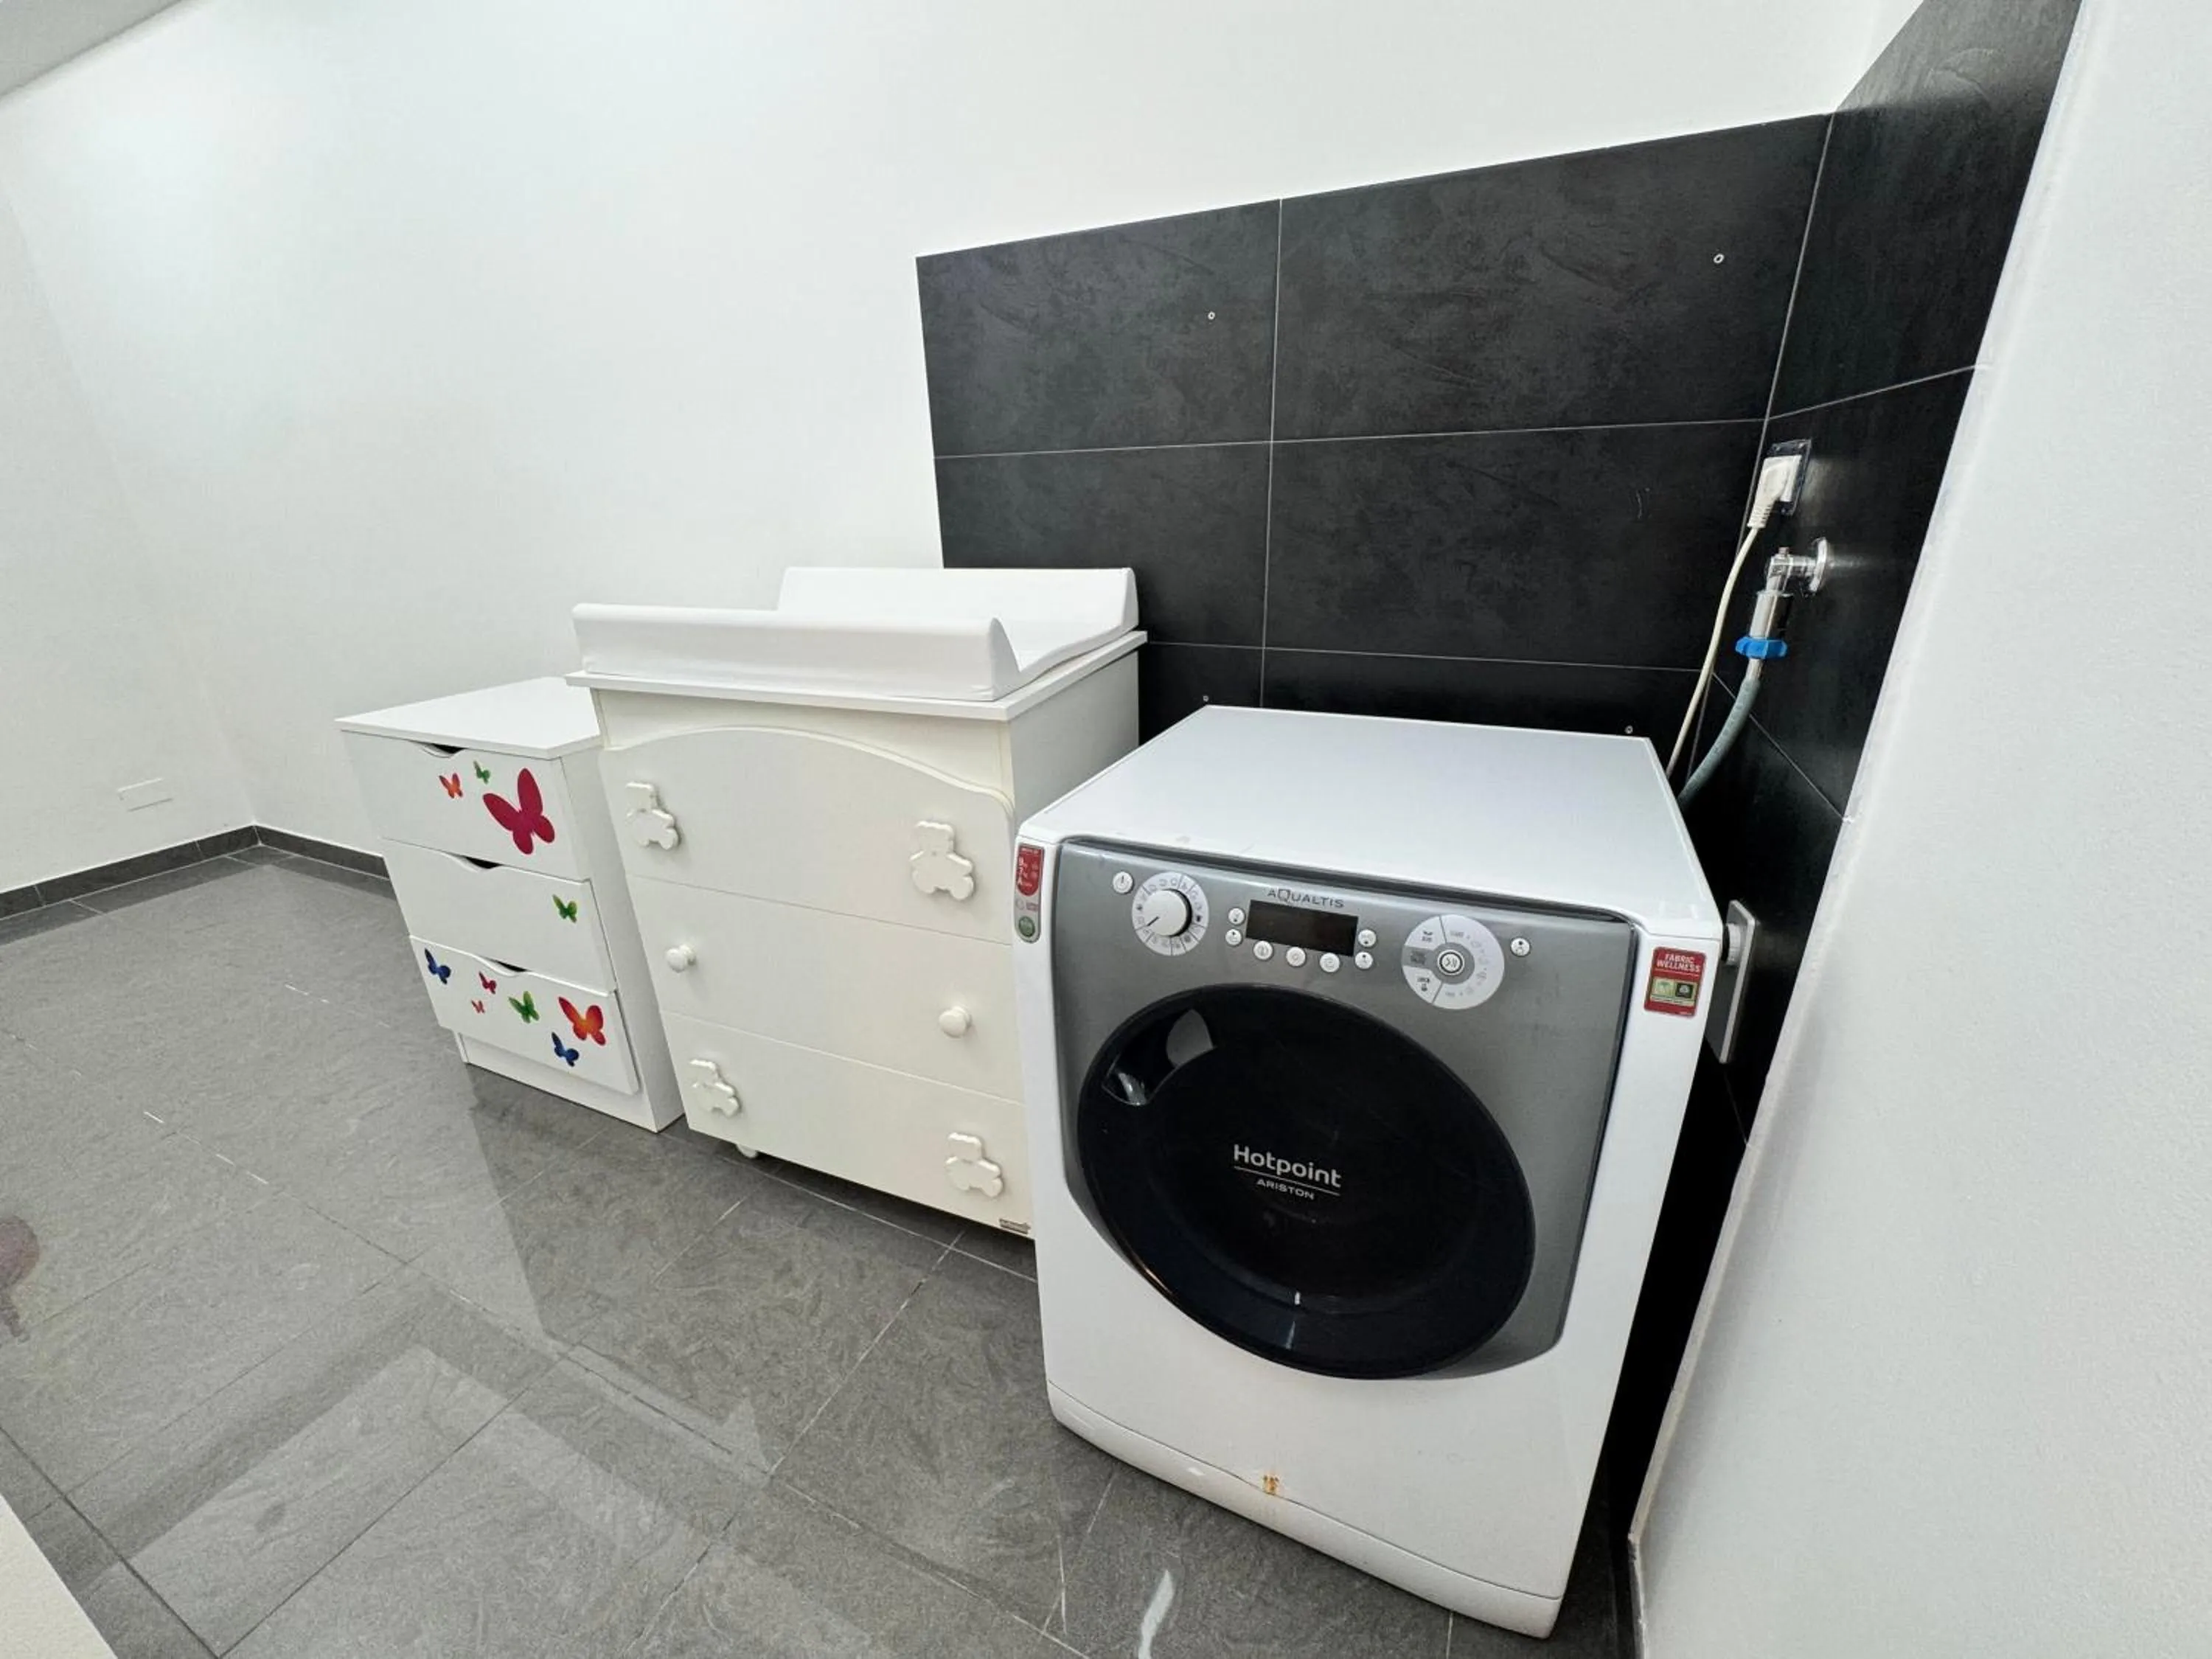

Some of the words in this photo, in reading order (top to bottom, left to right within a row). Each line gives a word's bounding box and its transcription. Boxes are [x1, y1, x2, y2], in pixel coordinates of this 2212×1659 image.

[1267, 888, 1345, 908] AQUALTIS
[1656, 959, 1701, 973] WELLNESS
[1665, 953, 1694, 964] FABRIC
[1234, 1144, 1342, 1188] Hotpoint
[1256, 1178, 1315, 1200] ARISTON
